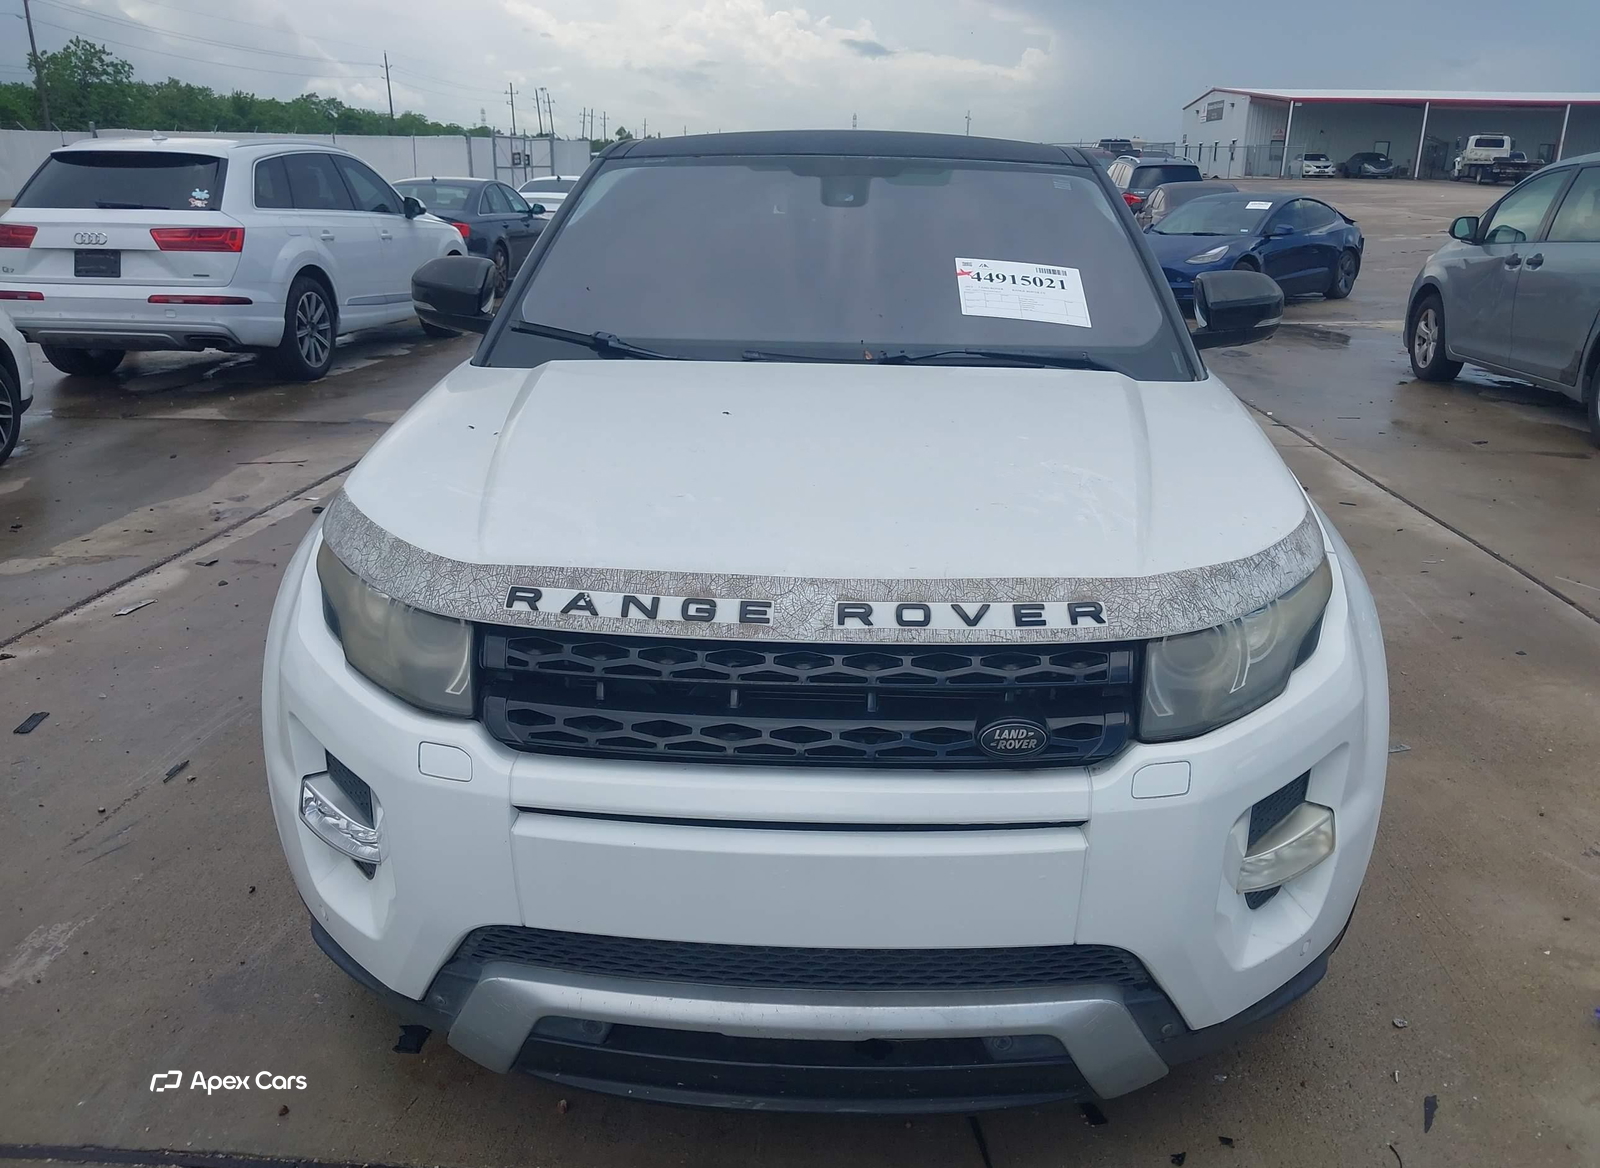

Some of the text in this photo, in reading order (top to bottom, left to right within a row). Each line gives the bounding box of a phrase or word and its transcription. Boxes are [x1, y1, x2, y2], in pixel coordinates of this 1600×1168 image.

[970, 271, 1067, 290] 44915021
[505, 586, 1107, 627] RANGE ROVER
